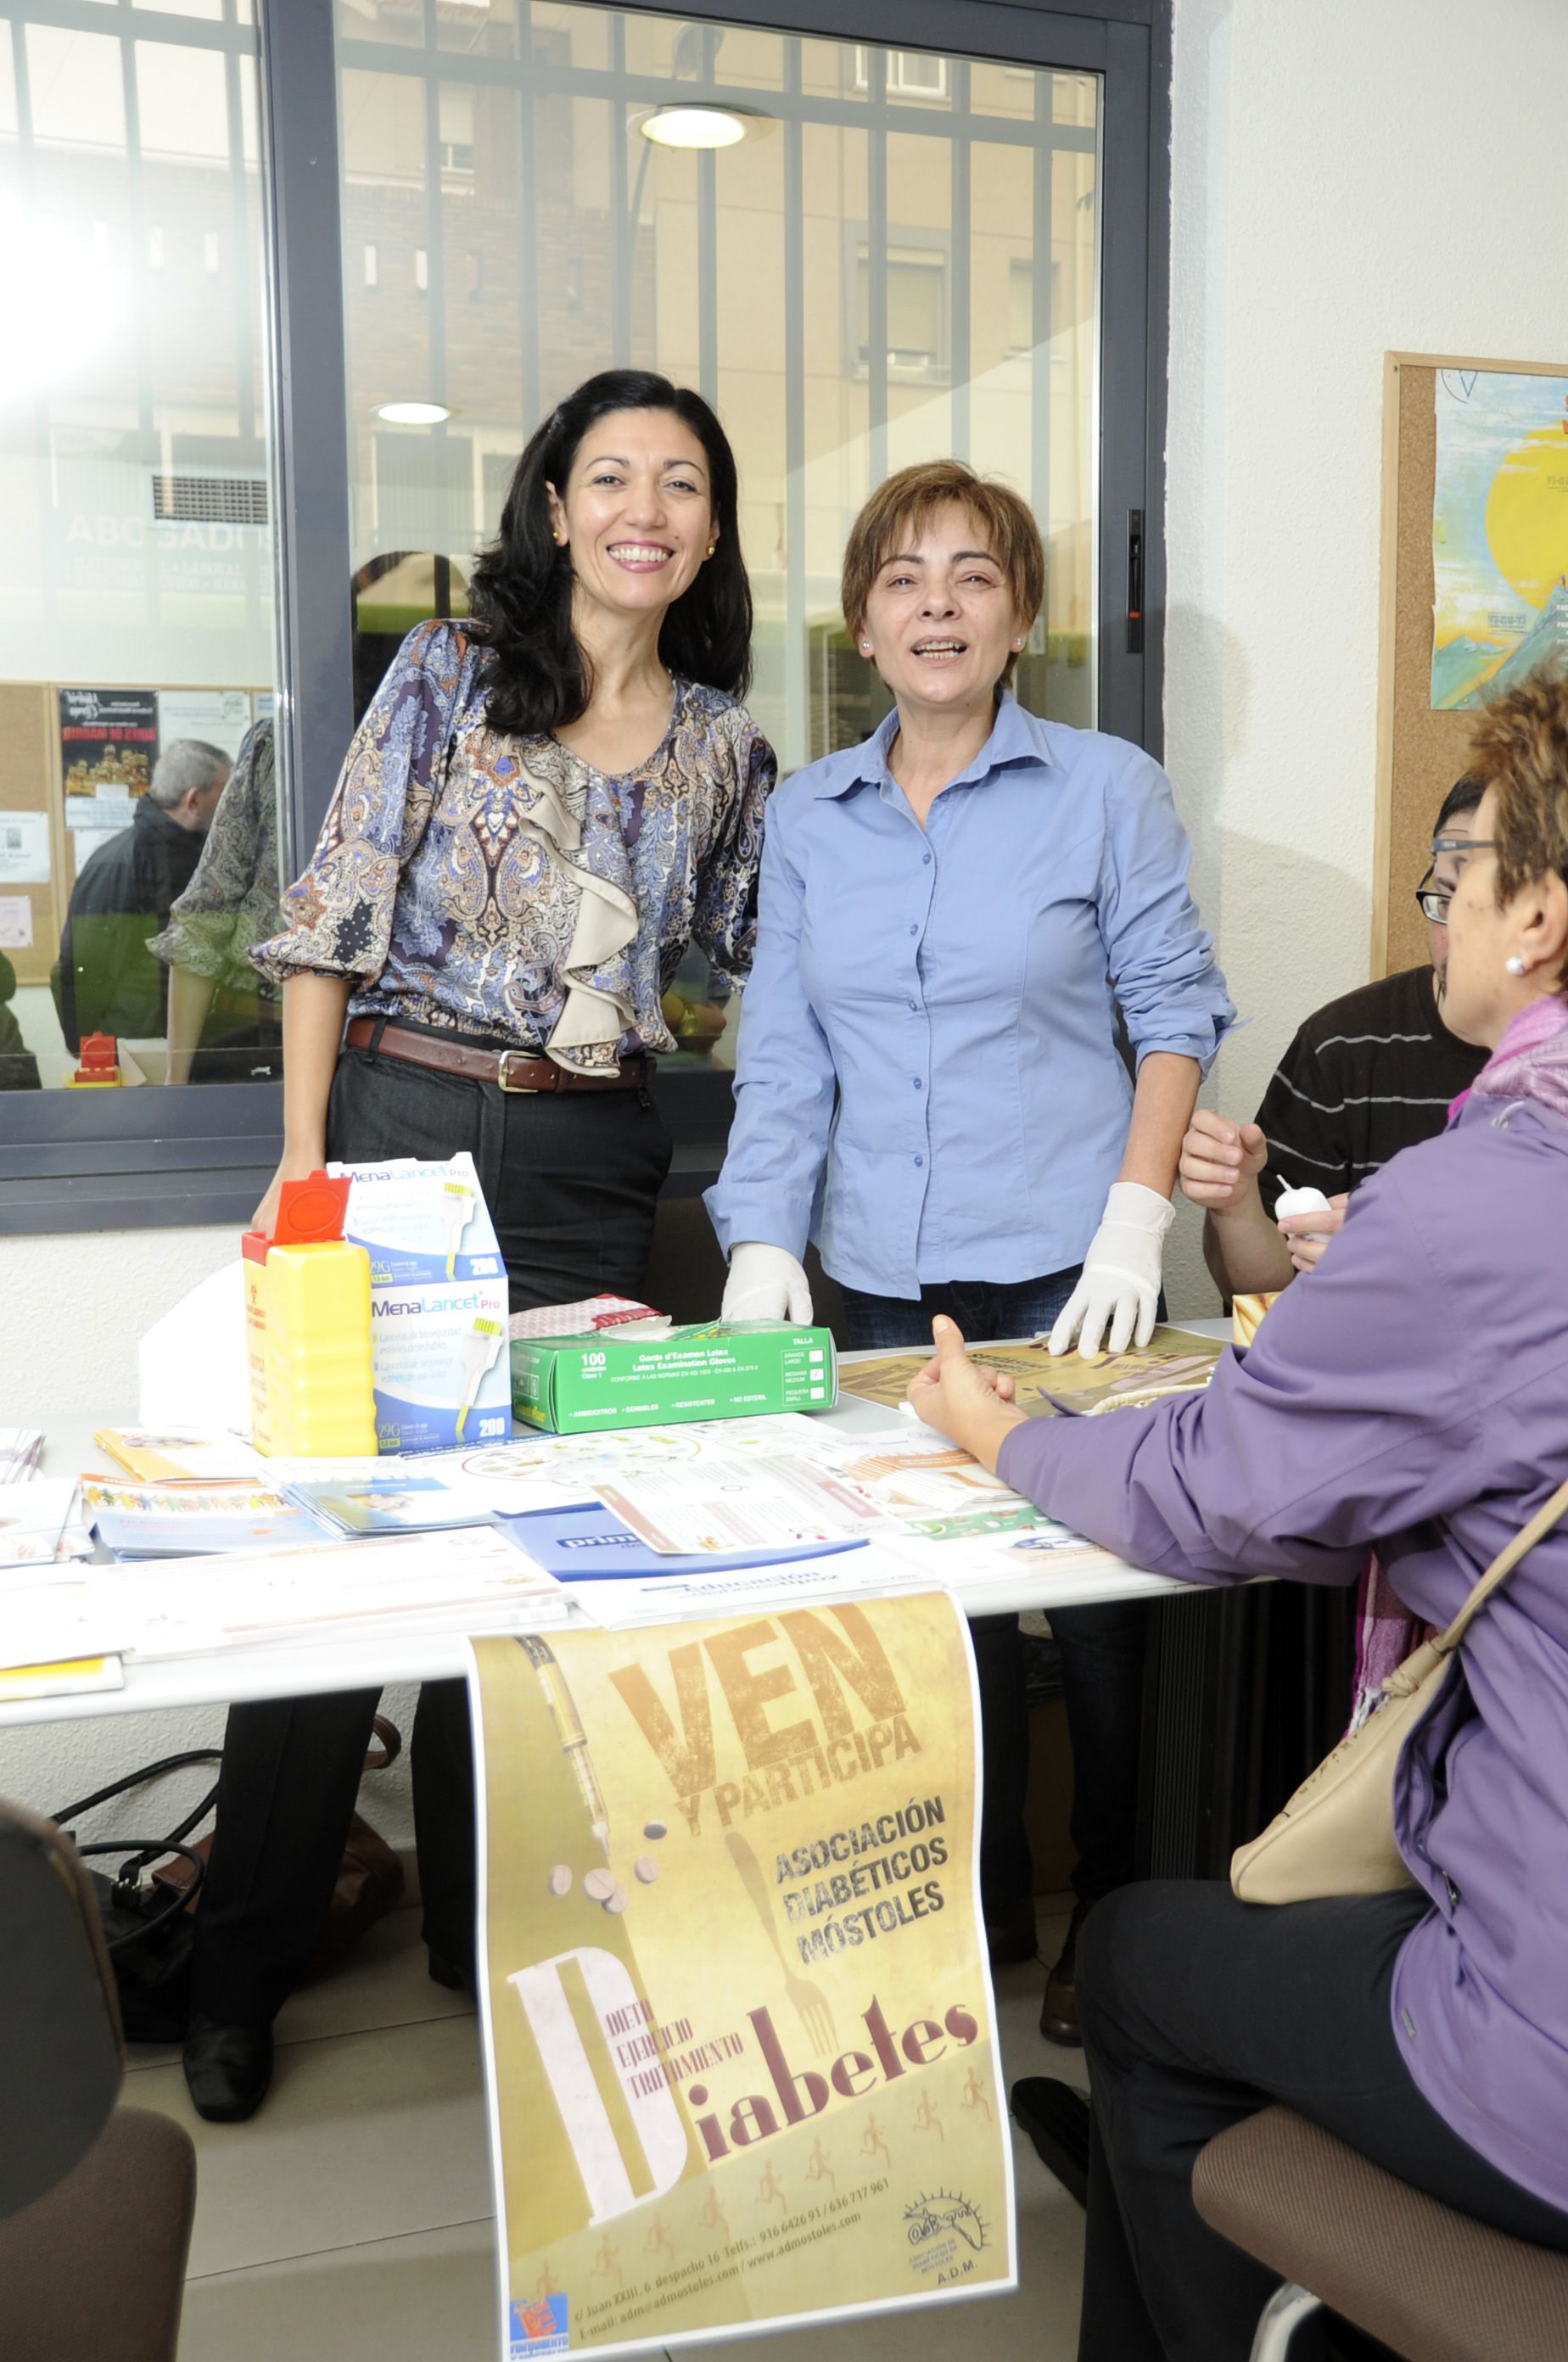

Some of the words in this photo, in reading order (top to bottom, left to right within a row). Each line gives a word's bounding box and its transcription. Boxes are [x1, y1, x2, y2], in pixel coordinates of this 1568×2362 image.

[449, 1169, 470, 1178] Pro
[470, 1257, 499, 1275] 200
[372, 1292, 479, 1318] MenaLancet
[480, 1300, 501, 1310] Pro
[581, 1352, 606, 1366] 100
[632, 1363, 654, 1372] Latex
[657, 1357, 708, 1369] Examination
[709, 1356, 736, 1365] Gloves
[639, 1353, 663, 1363] Gants
[664, 1351, 705, 1360] d'Examen
[707, 1348, 729, 1357] Latex
[378, 1422, 400, 1438] 29G
[479, 1416, 505, 1438] 200
[573, 1408, 618, 1418] AMBIDEXTROS
[625, 1403, 659, 1413] SENSIBLES
[675, 1398, 715, 1408] RESISTENTES
[607, 1602, 907, 1799] VEN
[675, 1793, 701, 1838] Y
[714, 1711, 923, 1827] PARTICIPA
[776, 1795, 946, 1885] ASOCIACIÓN
[782, 1836, 949, 1923] DIABÉTICOS
[796, 1880, 945, 1966] MÓSTOLES
[605, 1997, 655, 2037] DIETA
[616, 2017, 694, 2068] EJERCICIO
[627, 2031, 744, 2099] TRATAMIENTO
[587, 2298, 613, 2318] Juan
[613, 2286, 643, 2306] XXIII,
[643, 2281, 652, 2292] 6
[655, 2260, 705, 2288] despacho
[706, 2251, 720, 2266] 16
[759, 2225, 781, 2243] 916
[829, 2195, 849, 2214] 636
[849, 2186, 868, 2205] 717
[870, 2176, 890, 2196] 961
[619, 2260, 739, 2324] adm@admostoles.com
[747, 2211, 861, 2270] www.admostoles.com
[938, 2258, 979, 2286] A.D.M.
